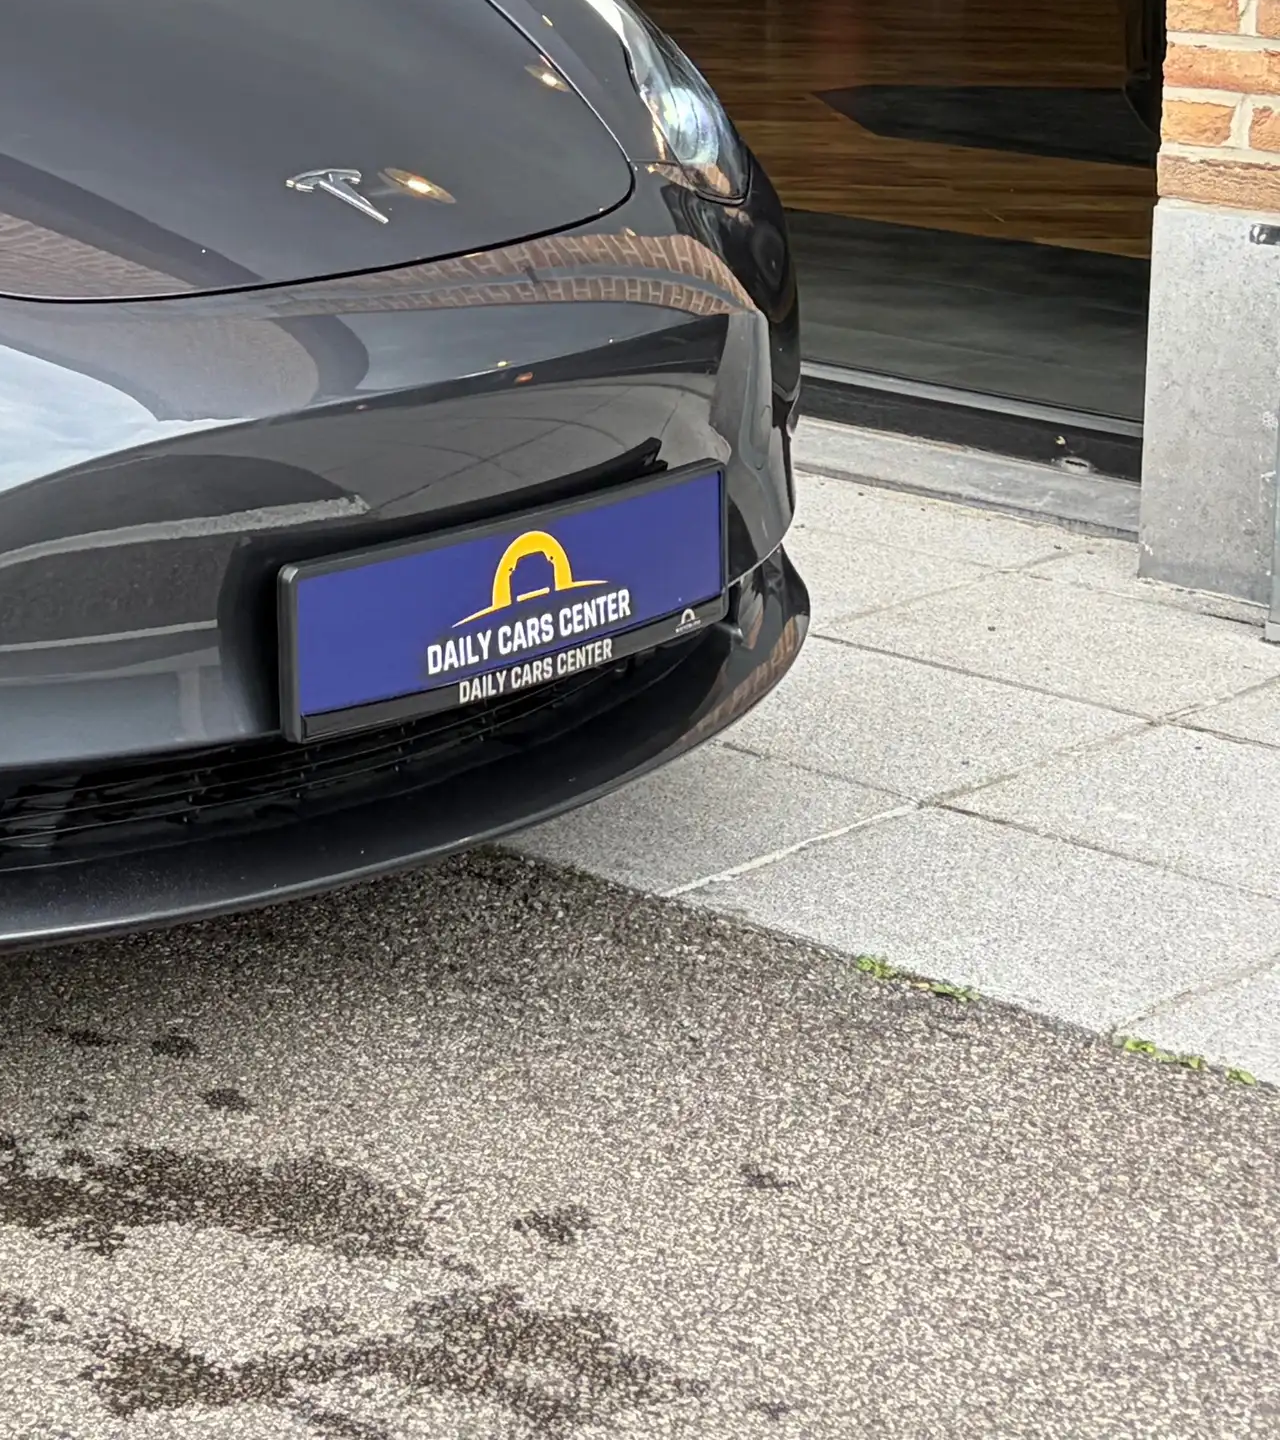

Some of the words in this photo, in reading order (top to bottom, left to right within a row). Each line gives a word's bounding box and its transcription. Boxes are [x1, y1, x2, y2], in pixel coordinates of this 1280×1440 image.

[427, 629, 492, 675] DAILY
[497, 614, 555, 655] CARS
[558, 588, 632, 638] CENTER
[458, 669, 507, 704] DAILY
[511, 656, 554, 689] CARS
[556, 638, 613, 675] CENTER
